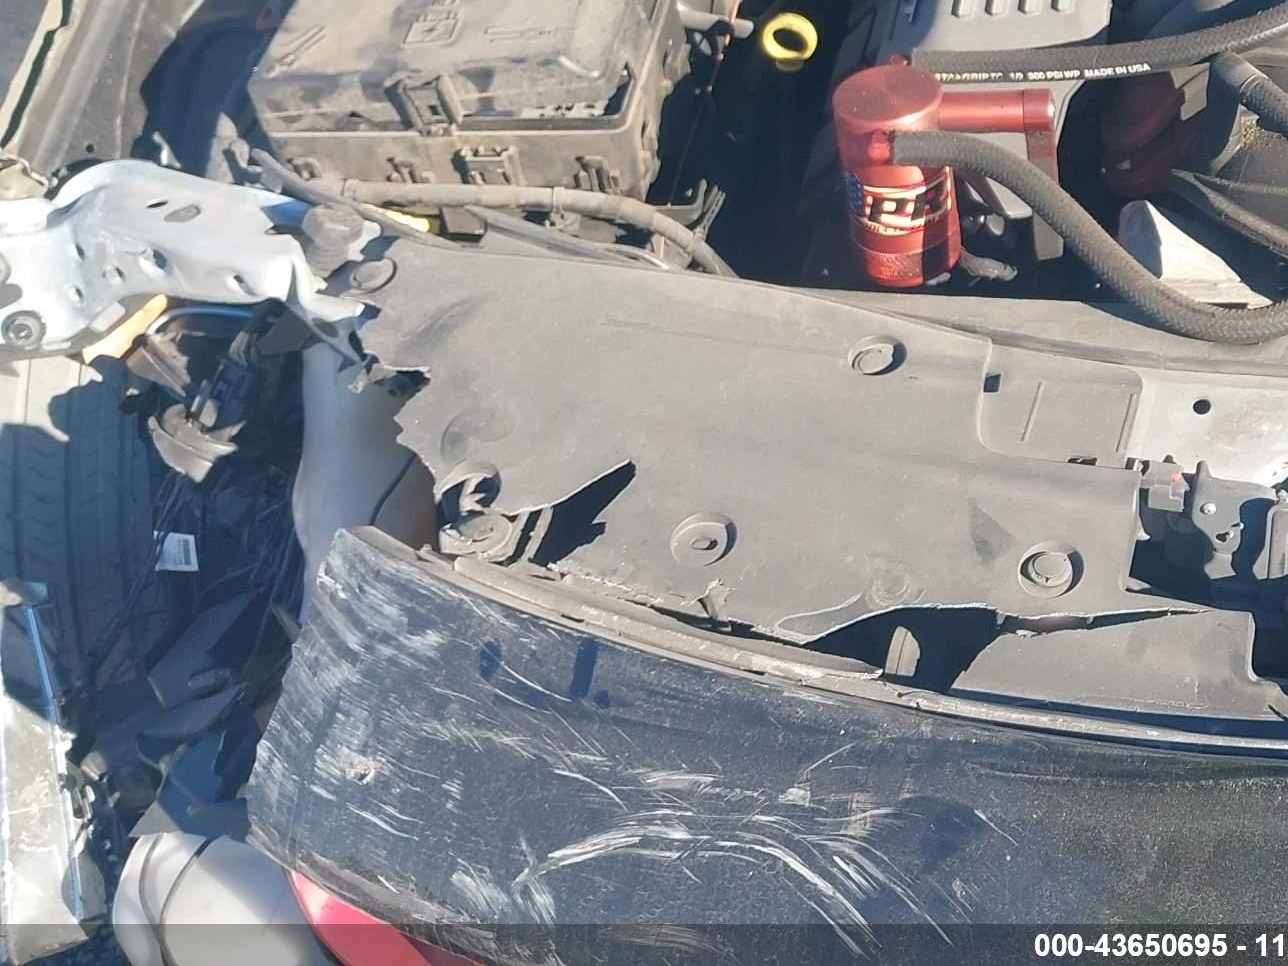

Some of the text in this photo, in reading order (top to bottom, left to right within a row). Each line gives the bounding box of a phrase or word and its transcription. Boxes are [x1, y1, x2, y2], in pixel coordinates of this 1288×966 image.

[1027, 71, 1045, 80] 300
[1046, 70, 1063, 80] PSI
[1063, 69, 1081, 79] WP
[1084, 67, 1115, 77] MADE
[1115, 66, 1127, 75] IN
[1128, 63, 1151, 74] USA
